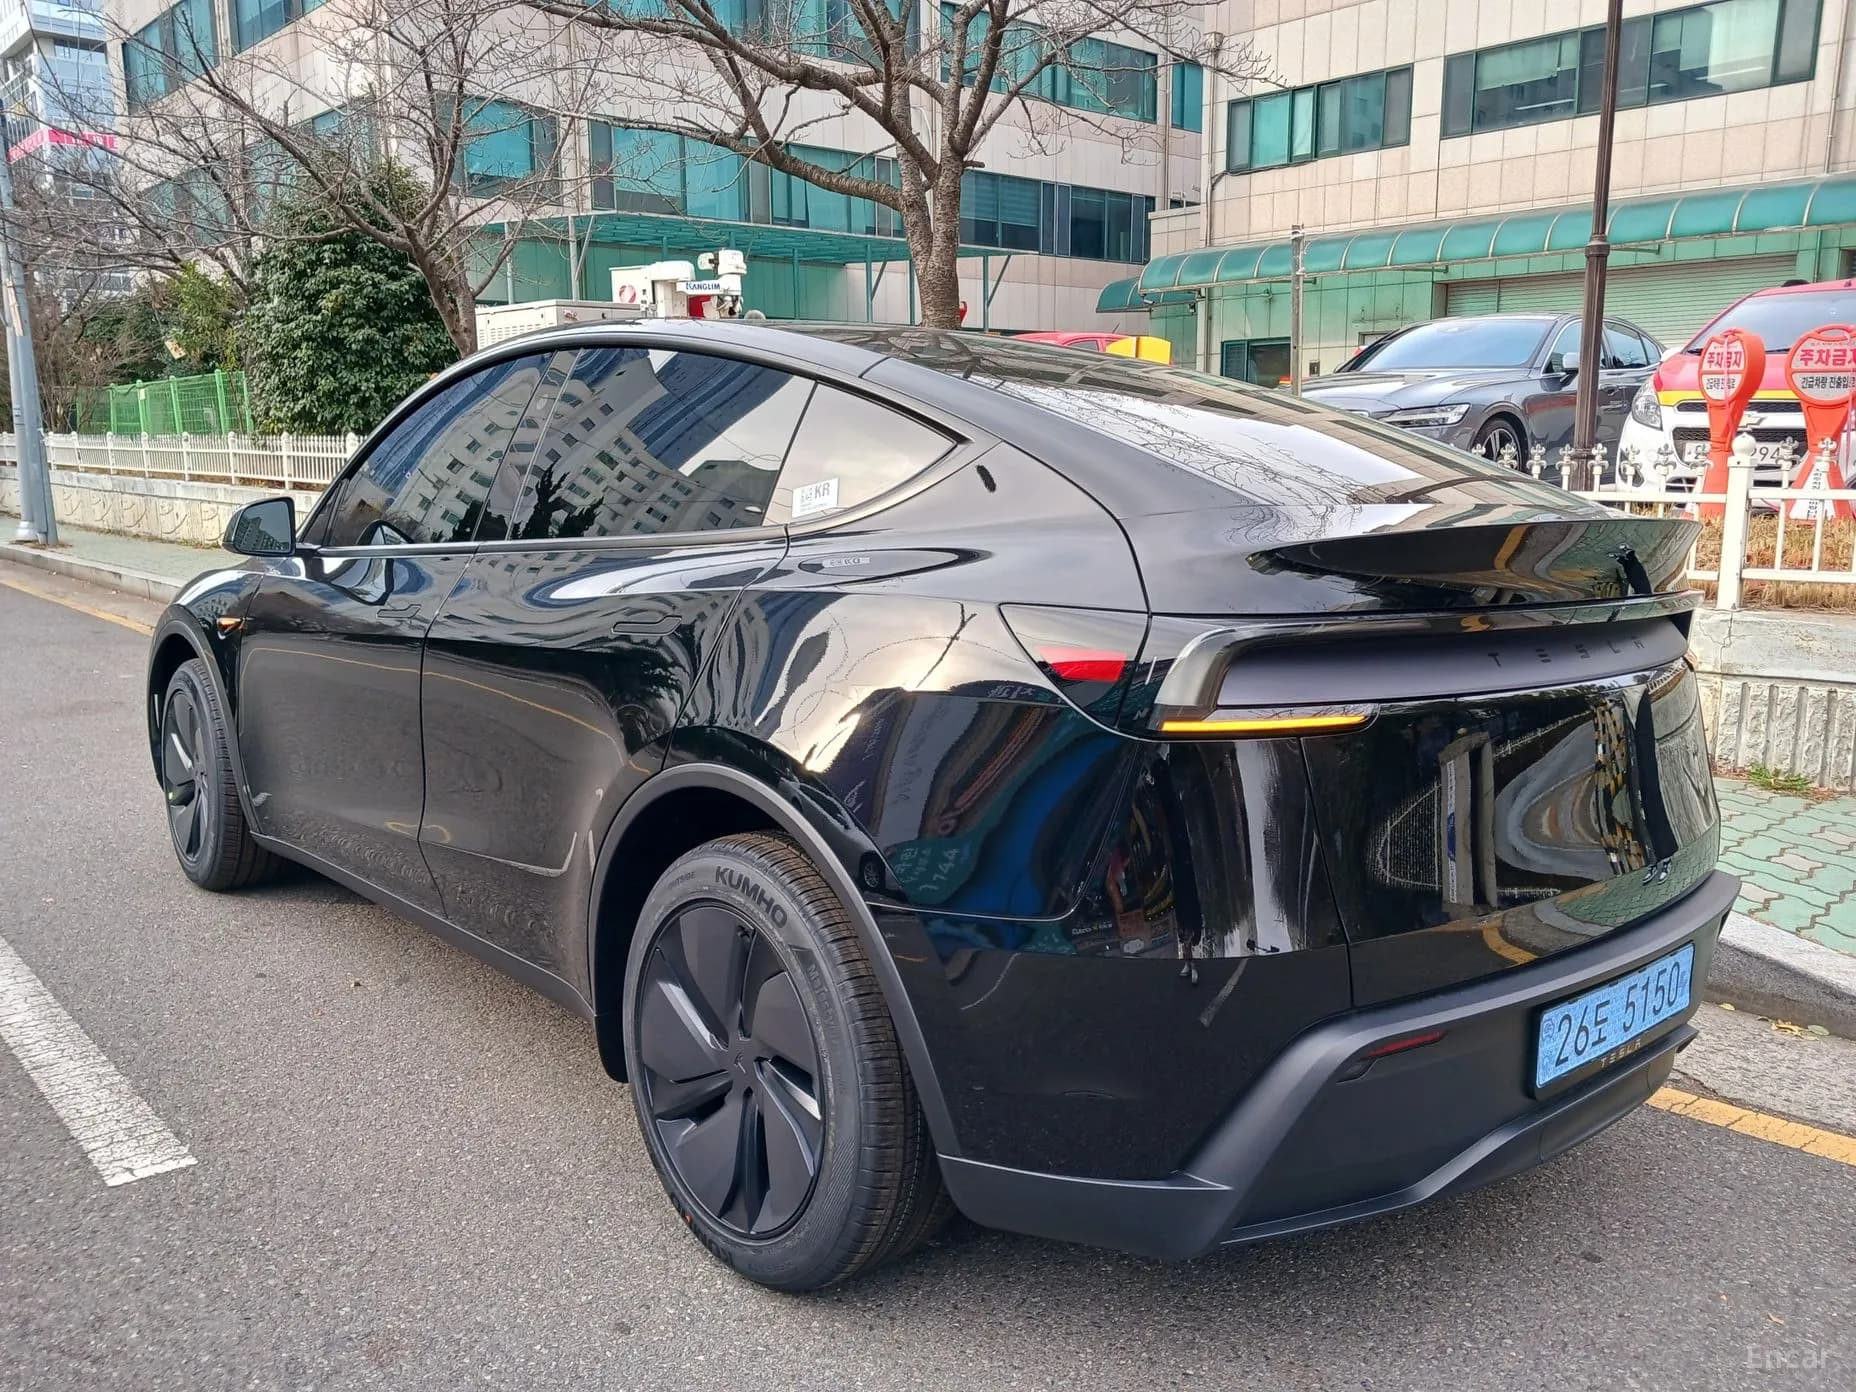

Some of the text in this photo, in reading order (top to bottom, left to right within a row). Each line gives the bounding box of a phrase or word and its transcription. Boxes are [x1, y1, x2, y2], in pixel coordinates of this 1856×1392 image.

[686, 282, 721, 291] KANGLIM
[715, 865, 788, 928] KUMHO
[1554, 961, 1681, 1068] 26도 5150
